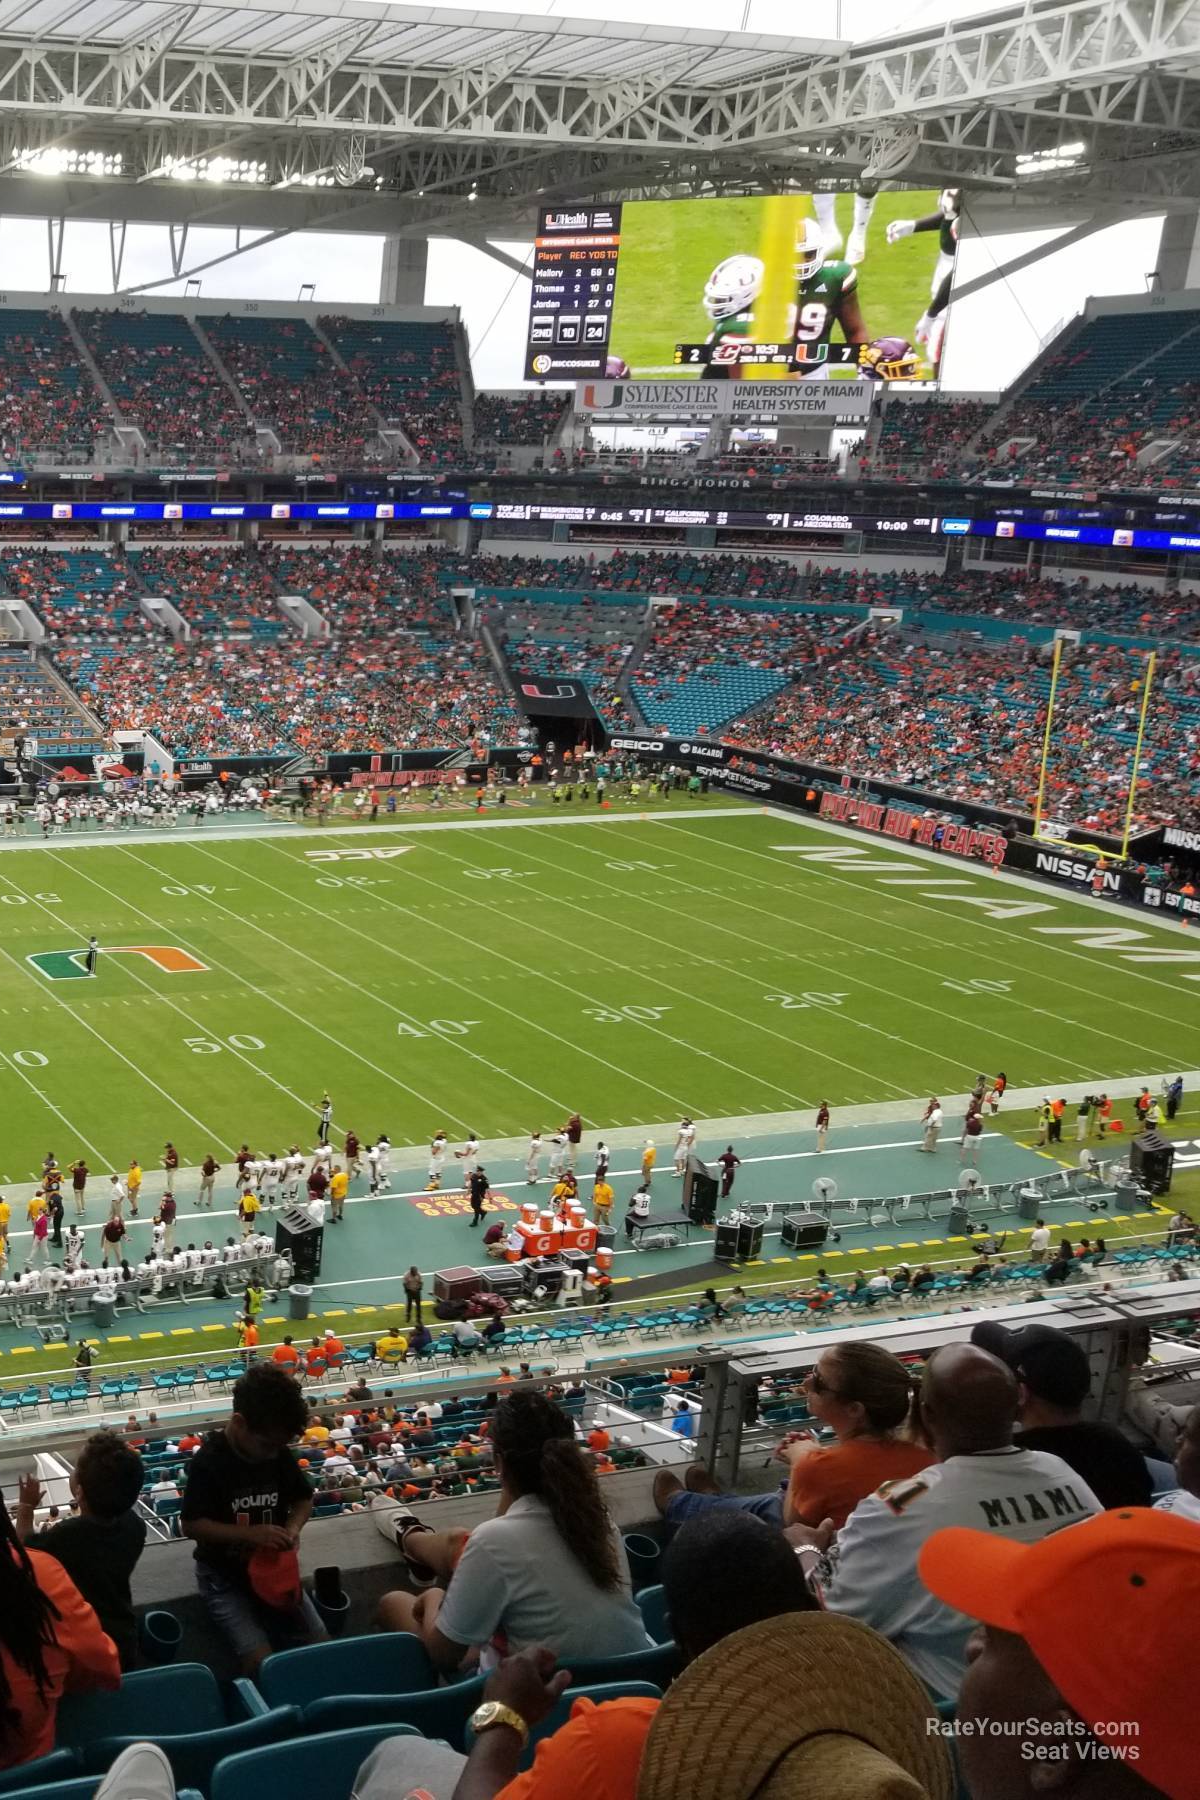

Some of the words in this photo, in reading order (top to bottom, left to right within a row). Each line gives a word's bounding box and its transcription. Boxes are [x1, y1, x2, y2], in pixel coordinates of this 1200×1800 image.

[538, 252, 562, 261] Player
[570, 251, 587, 260] REC
[589, 250, 606, 259] YDS
[607, 250, 618, 259] TD
[536, 268, 564, 278] Mallory
[576, 268, 582, 277] 2
[608, 268, 615, 276] 0
[535, 284, 565, 293] Thomas
[574, 284, 580, 293] 2
[590, 284, 599, 293] 10
[606, 284, 613, 292] 0
[120, 298, 135, 308] 349
[533, 300, 561, 309] Jordan
[574, 300, 578, 308] 1
[587, 299, 600, 308] 27
[605, 299, 612, 307] 0
[533, 328, 553, 338] 2ND
[562, 327, 575, 338] 10
[587, 326, 603, 338] 24
[690, 348, 700, 362] 2
[841, 347, 851, 361] 7
[625, 386, 718, 403] SYLVESTER
[734, 385, 803, 397] UNIVERSITY
[805, 385, 821, 397] OF
[822, 385, 864, 398] MIAMI
[732, 399, 776, 410] HEALTH
[779, 399, 827, 411] SYSTEM
[640, 477, 679, 487] RING
[694, 479, 751, 488] HONOR
[496, 511, 526, 519] SCORES
[601, 512, 623, 521] 0:45
[665, 510, 710, 518] CALIFORNIA
[804, 514, 849, 523] COLORADO
[803, 520, 832, 528] ARIZONA
[832, 521, 853, 529] STATE
[876, 520, 908, 531] 10:00
[913, 518, 931, 526] QTR
[611, 738, 664, 752] GEICO
[1, 892, 64, 905] 50
[939, 978, 1013, 995] 10
[764, 990, 843, 1010] 20
[581, 1004, 663, 1024] 30
[397, 1018, 469, 1039] 40
[183, 1034, 267, 1054] 50
[537, 1236, 551, 1251] G
[576, 1232, 590, 1247] G
[232, 1492, 279, 1513] young
[979, 1484, 1088, 1528] MIAMI
